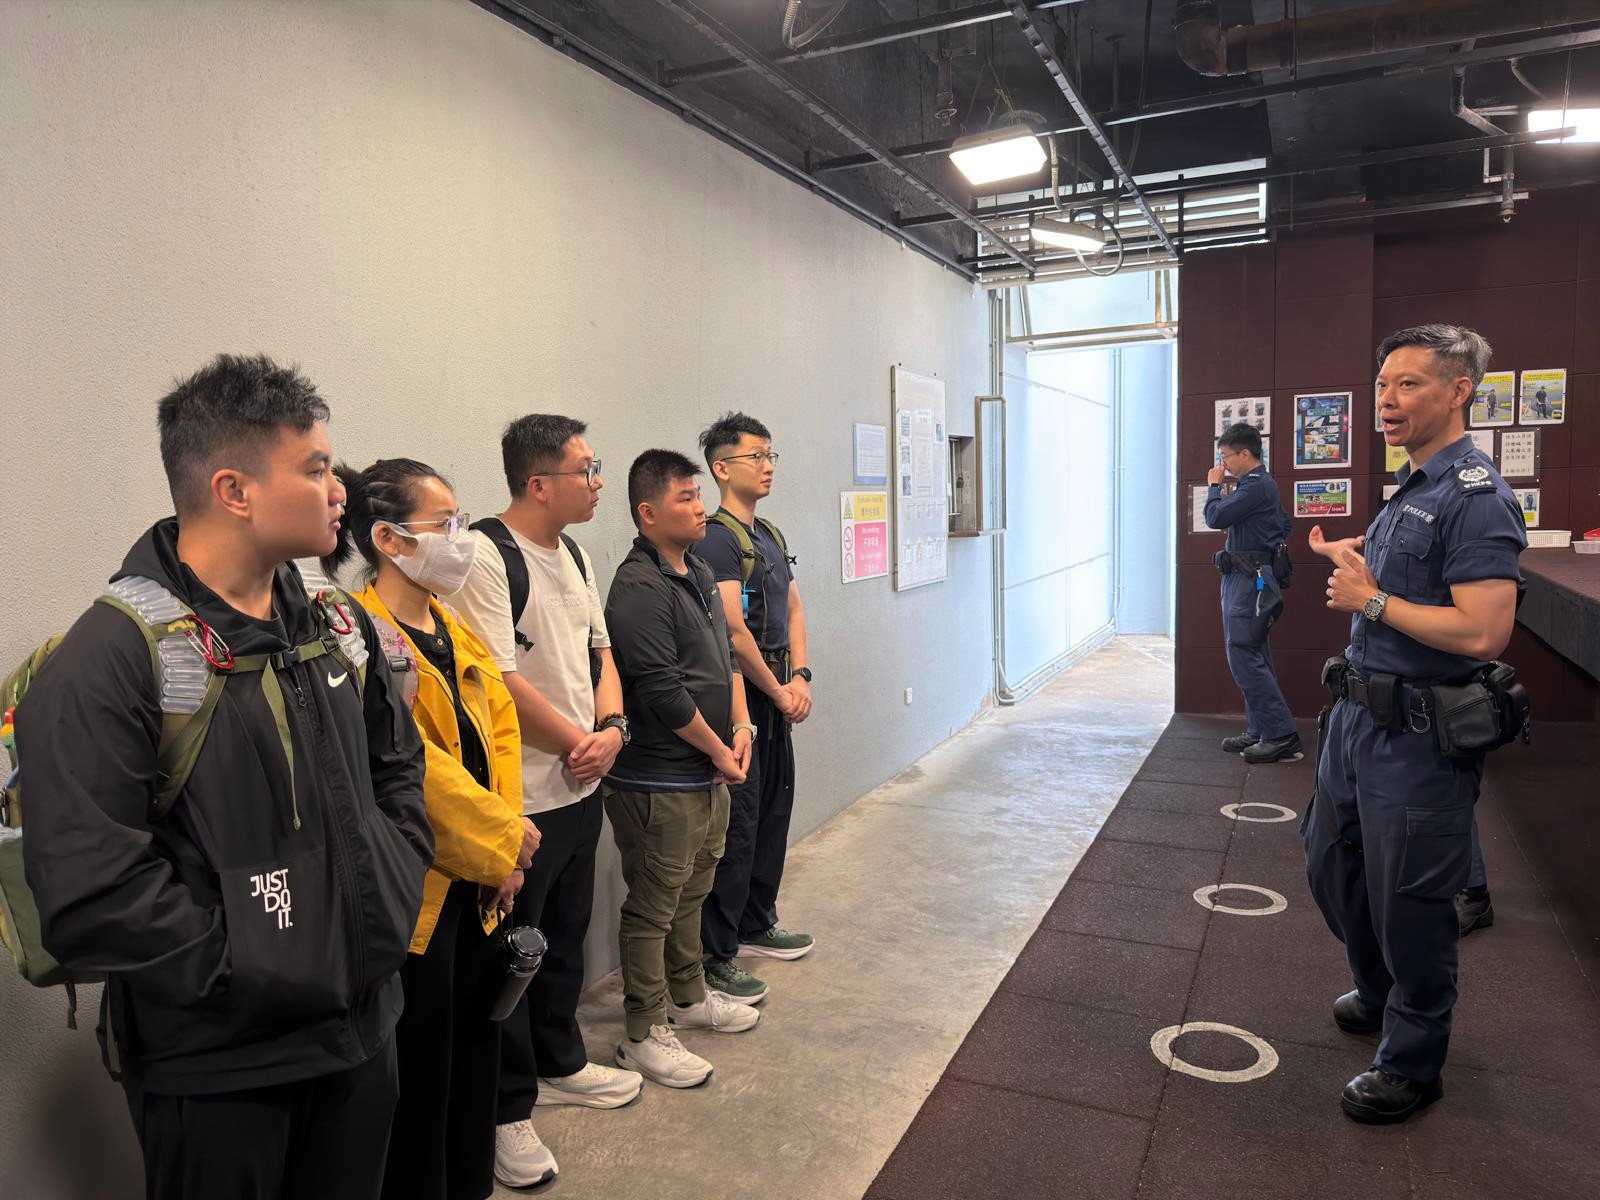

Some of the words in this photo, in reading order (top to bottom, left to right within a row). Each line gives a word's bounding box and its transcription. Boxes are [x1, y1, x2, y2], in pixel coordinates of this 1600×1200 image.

[250, 868, 289, 897] JUST
[264, 888, 291, 913] DO
[278, 906, 294, 930] IT.
